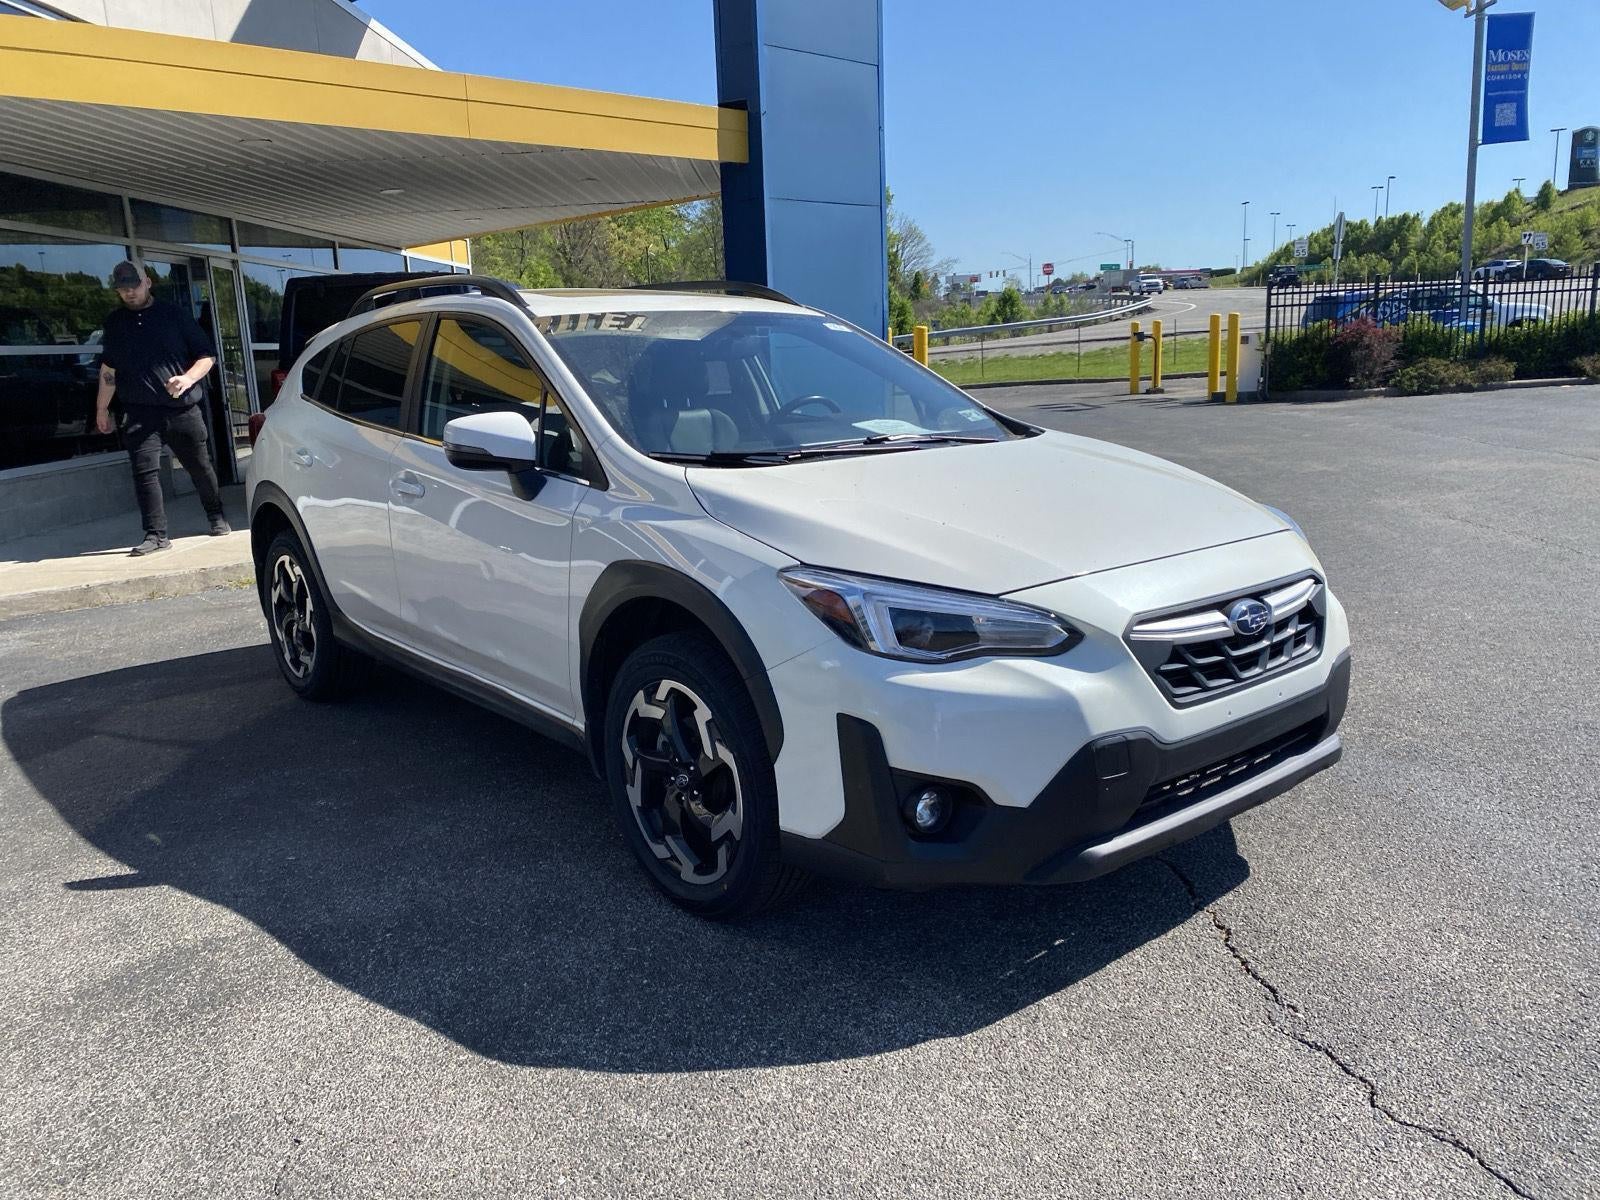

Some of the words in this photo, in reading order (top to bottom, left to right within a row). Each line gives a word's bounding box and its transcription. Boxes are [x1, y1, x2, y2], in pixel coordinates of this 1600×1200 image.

[1489, 49, 1530, 63] MOSES
[1535, 241, 1547, 249] 55
[1295, 248, 1307, 257] 55
